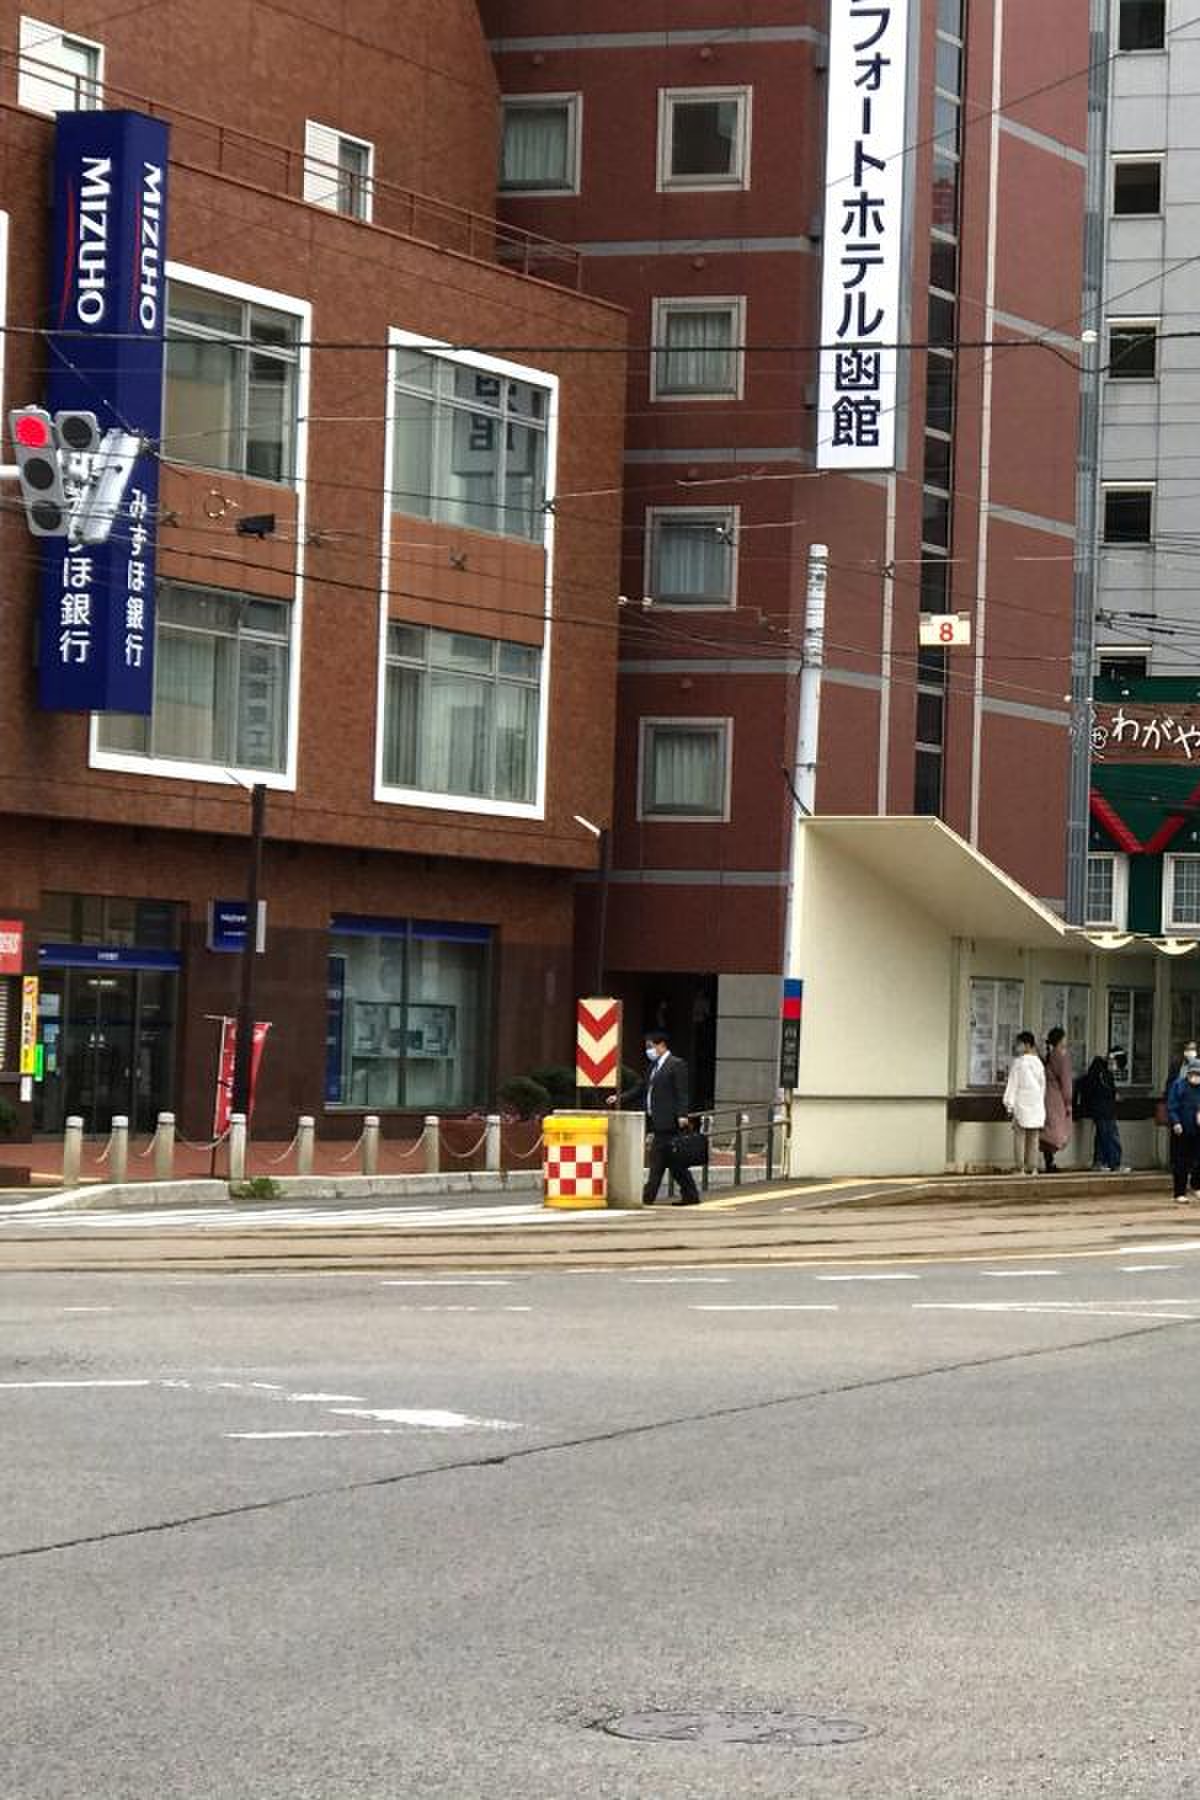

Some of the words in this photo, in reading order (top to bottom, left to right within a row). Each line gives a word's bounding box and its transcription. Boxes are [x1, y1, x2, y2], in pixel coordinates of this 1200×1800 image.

[77, 156, 113, 324] MIZUHO
[139, 161, 165, 330] MIZUHO
[832, 0, 891, 448] フォートホテル函館
[125, 487, 148, 668] みずほ銀行
[939, 621, 954, 642] 8
